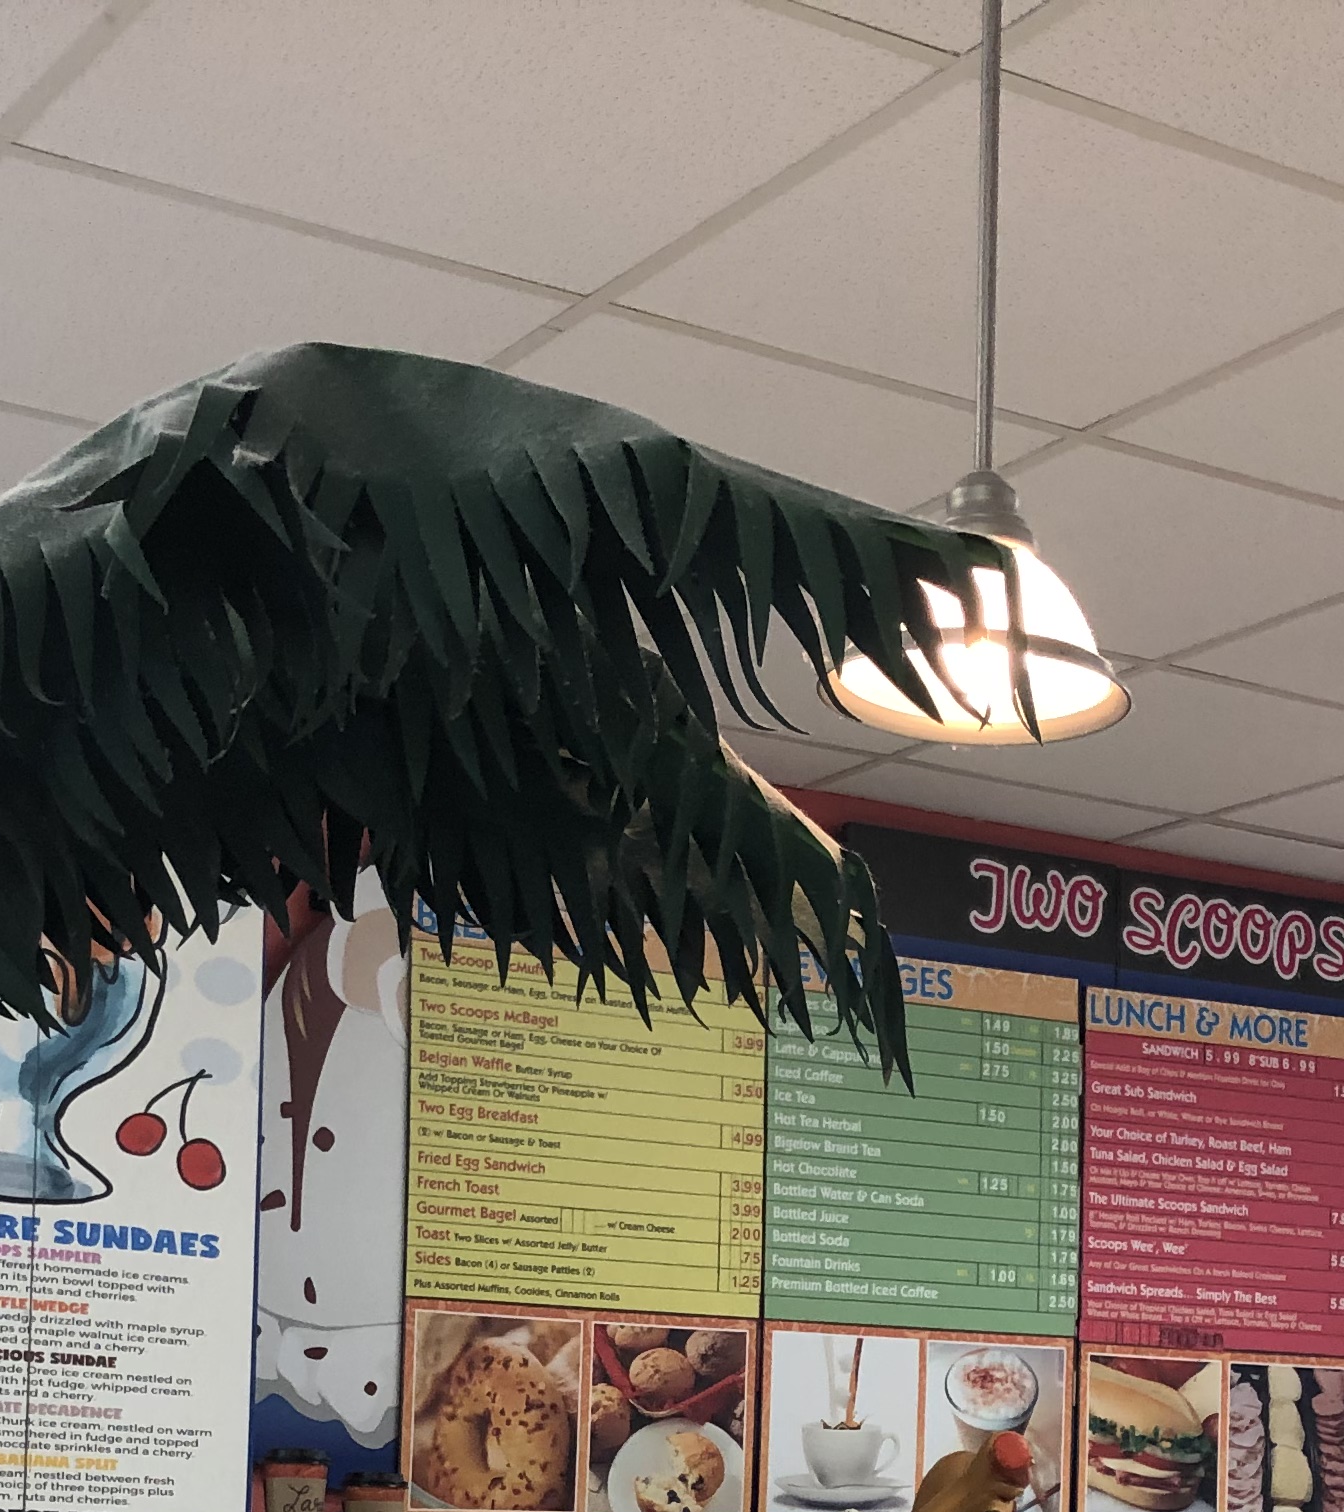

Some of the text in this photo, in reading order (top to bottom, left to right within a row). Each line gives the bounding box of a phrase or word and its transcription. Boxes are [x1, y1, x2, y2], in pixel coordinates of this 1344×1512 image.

[419, 999, 559, 1028] Two Scoops McBagel
[1089, 993, 1309, 1048] LUNCH & MORE
[418, 1050, 512, 1072] Belgian Waffle
[775, 1065, 844, 1085] Iced Coffee
[774, 1088, 816, 1105] Ice Tea
[1091, 1081, 1197, 1104] Great Sub Sandwich
[418, 1100, 539, 1125] Two Egg Breakfast
[1090, 1125, 1113, 1139] Your
[1116, 1127, 1153, 1142] Choice
[1156, 1132, 1167, 1143] of
[1208, 1136, 1237, 1150] Roast
[1268, 1142, 1292, 1156] Ham
[418, 1151, 546, 1174] Fried Egg Sandwich
[773, 1160, 857, 1178] Hot Chocolate
[417, 1175, 500, 1195] French Toast
[773, 1182, 925, 1207] Bottled Water & Can Soda
[416, 1202, 517, 1222] Gourmet Bagel
[1089, 1191, 1249, 1217] The Ultimate Scoops Sandwich
[773, 1205, 849, 1224] Bottled Juice
[53, 1219, 221, 1259] SUNDAES
[416, 1226, 451, 1242] Toast
[772, 1229, 850, 1247] Bottled Soda
[28, 1246, 102, 1264] SAMPLER
[415, 1251, 452, 1267] Sides
[772, 1253, 861, 1272] Fountain Drinks
[44, 1263, 119, 1277] homemade
[121, 1270, 139, 1280] ice
[772, 1276, 939, 1299] Premium Bottled Iced Coffee
[1088, 1280, 1137, 1297] Sandwich
[1196, 1288, 1231, 1304] Simply
[1234, 1290, 1252, 1303] The
[1254, 1293, 1277, 1306] Best
[33, 1300, 89, 1315] WEDGE
[50, 1352, 117, 1368] SUNDAE
[28, 1402, 123, 1420] DECADENCE
[75, 1456, 119, 1471] SPLIT
